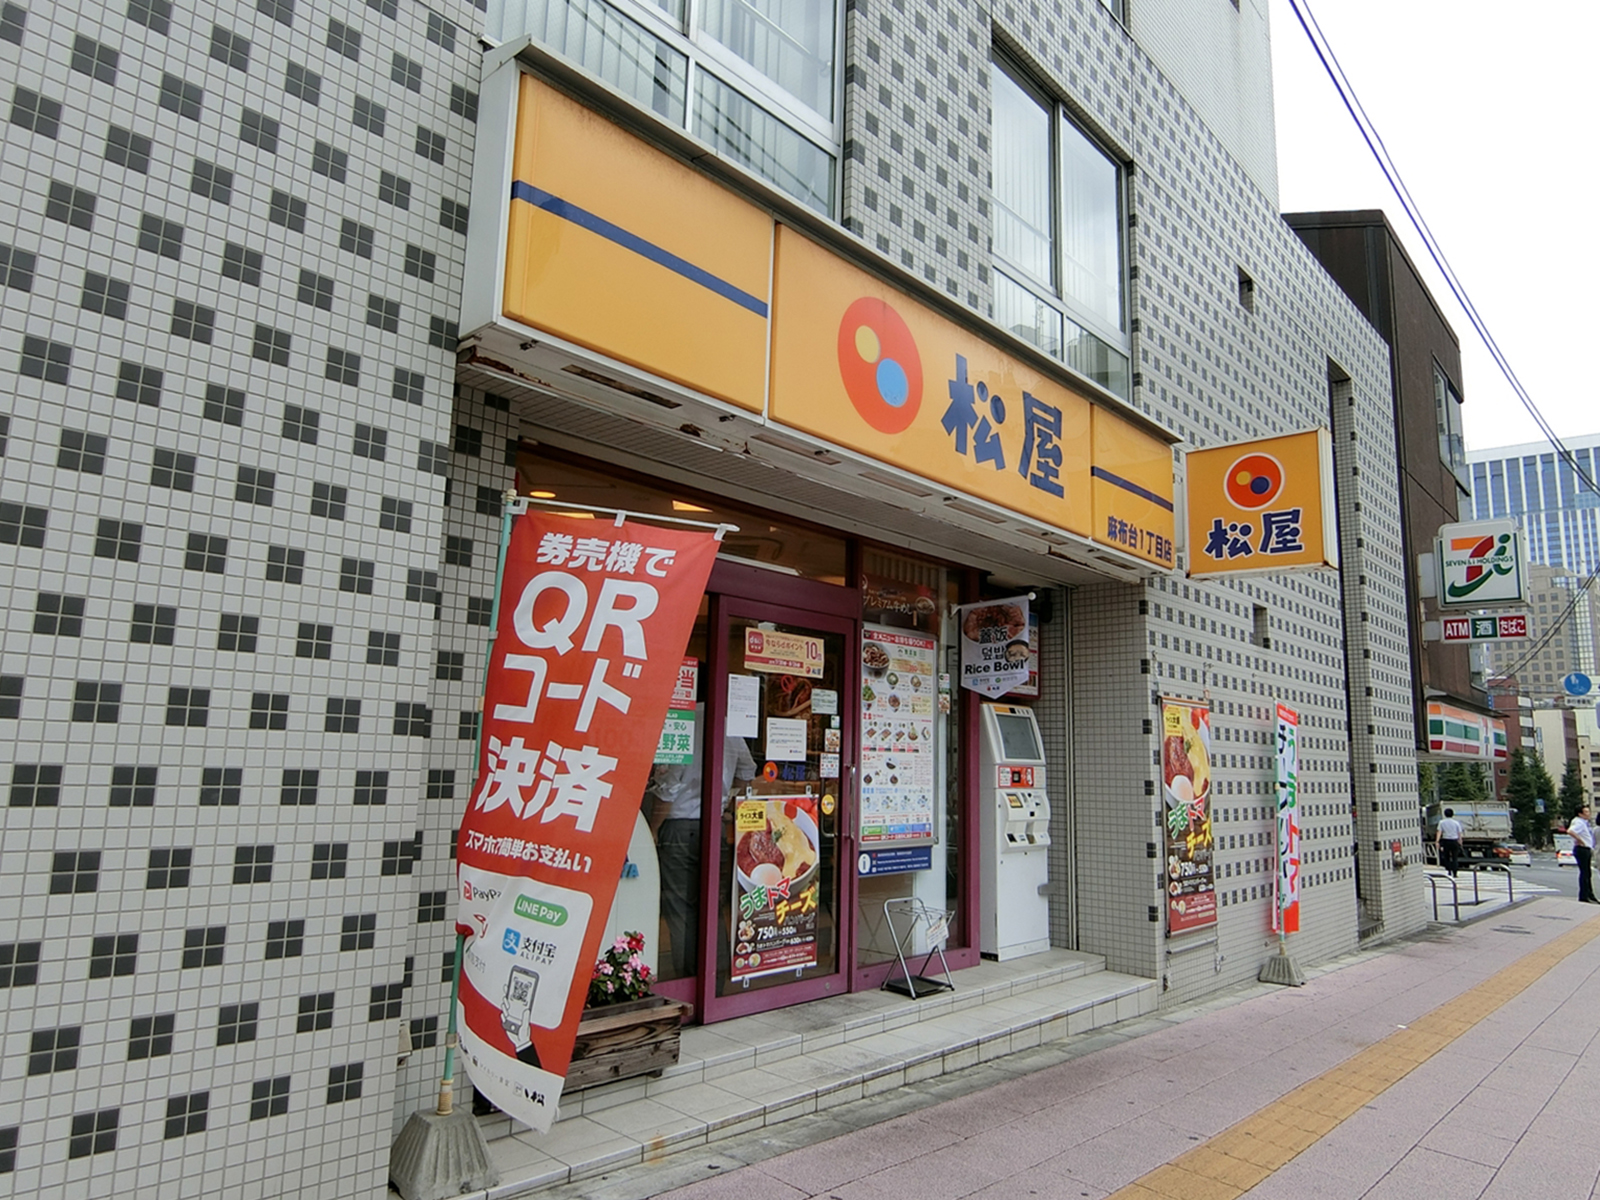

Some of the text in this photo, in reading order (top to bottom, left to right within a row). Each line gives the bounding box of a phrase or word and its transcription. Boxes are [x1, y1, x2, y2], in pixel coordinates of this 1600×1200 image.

[941, 352, 1064, 499] 松屋
[1107, 516, 1173, 563] 麻布台1丁目店
[1203, 508, 1304, 560] 松屋
[536, 532, 676, 578] 券売機で
[1445, 559, 1466, 568] SEVEN
[1476, 554, 1514, 565] HOLDINGS
[513, 570, 660, 661] QR
[1445, 621, 1468, 638] ATM
[1475, 620, 1493, 637] 酒
[1500, 618, 1526, 634] たばこ
[964, 659, 1025, 675] Rice Bowl
[493, 653, 643, 732] コード
[657, 733, 690, 751] 野菜
[475, 736, 620, 833] 決済
[1168, 797, 1207, 839] うまトマ
[1186, 818, 1212, 859] チーズ
[465, 830, 592, 873] スマホで簡単お支払い
[516, 898, 561, 924] LINE Pay
[740, 878, 791, 920] うまトマ
[776, 886, 817, 925] チーズ
[520, 951, 554, 967] ALIPAY
[522, 935, 557, 959] 支付宝
